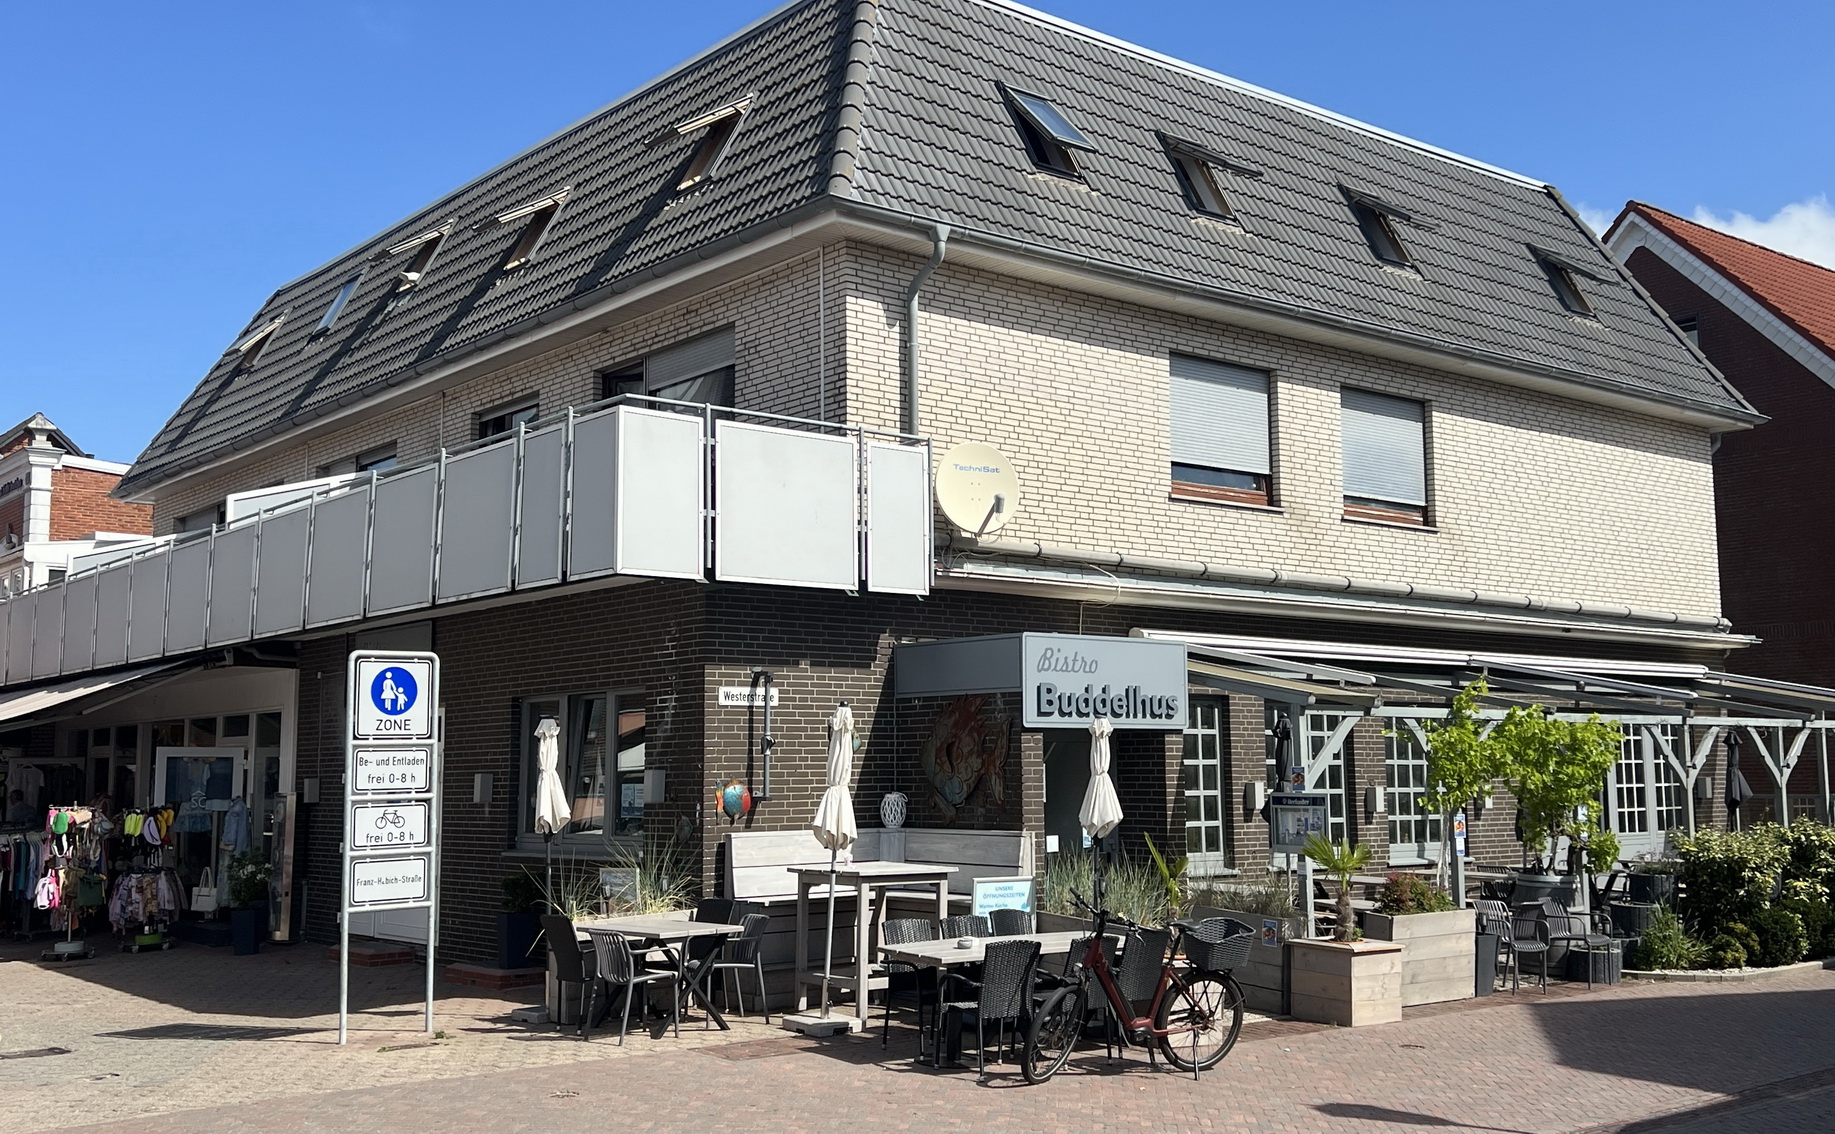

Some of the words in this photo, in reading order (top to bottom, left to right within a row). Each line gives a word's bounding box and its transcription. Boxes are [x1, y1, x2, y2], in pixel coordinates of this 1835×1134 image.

[953, 463, 1000, 473] TechniSat
[1037, 647, 1098, 673] Bistro
[723, 691, 774, 702] Westerstrae
[1037, 682, 1179, 720] Buddelhus
[375, 719, 411, 731] ZONE
[359, 757, 373, 767] Be-
[376, 757, 390, 766] und
[392, 756, 424, 766] Entladen
[368, 774, 385, 784] frei
[389, 773, 407, 783] 0-8
[411, 773, 416, 782] h
[366, 833, 383, 843] frei
[387, 831, 405, 842] 0-8
[409, 831, 414, 841] h
